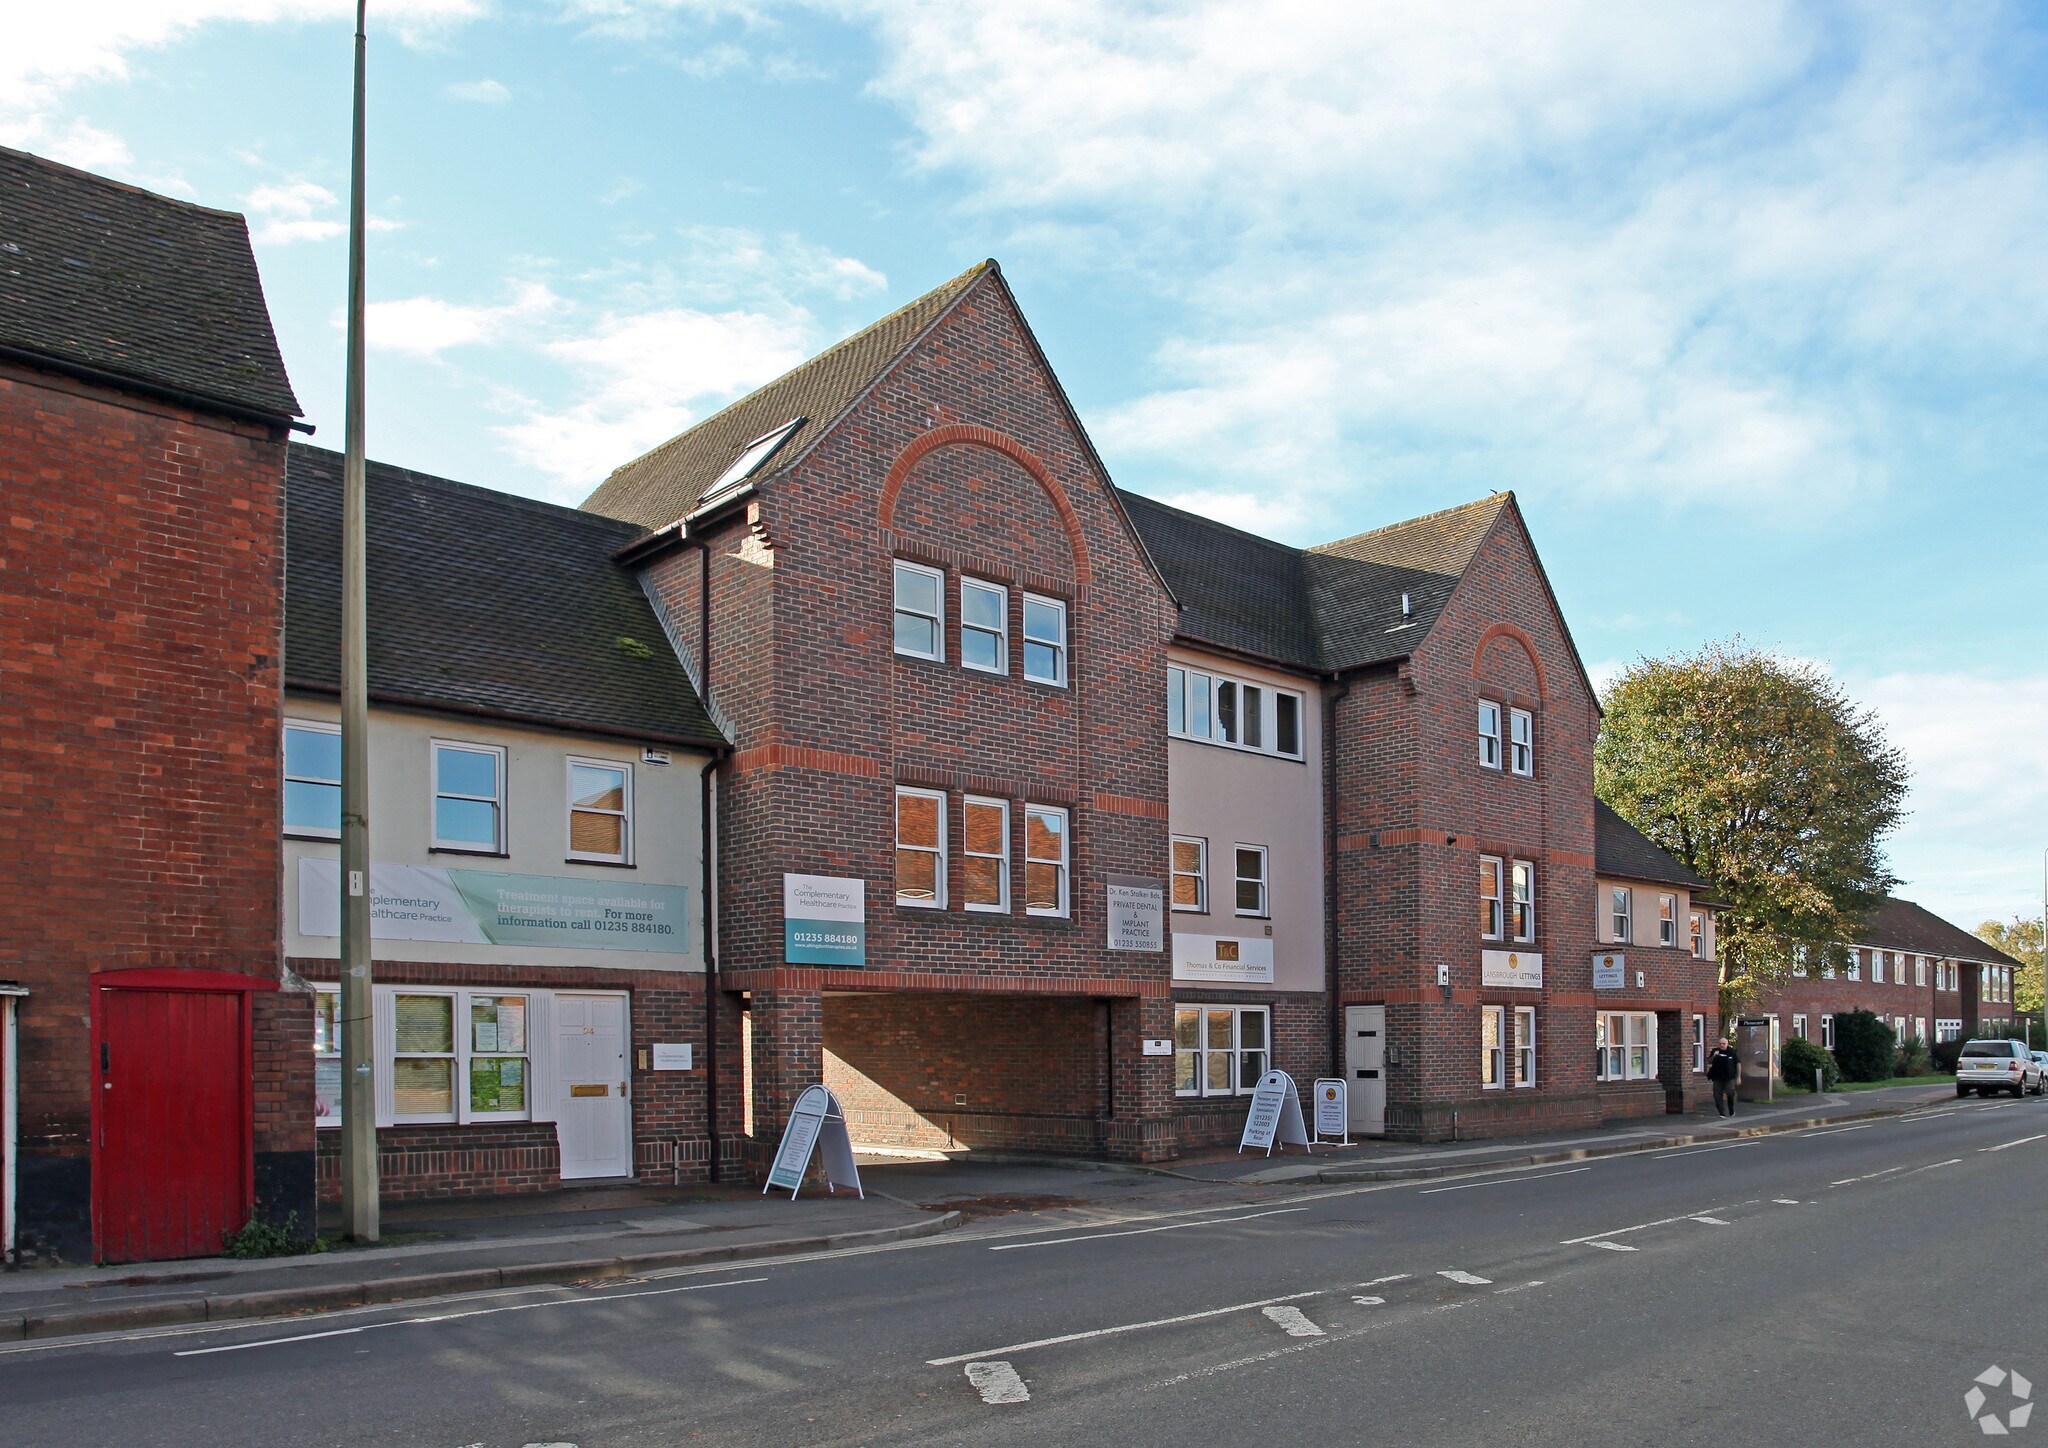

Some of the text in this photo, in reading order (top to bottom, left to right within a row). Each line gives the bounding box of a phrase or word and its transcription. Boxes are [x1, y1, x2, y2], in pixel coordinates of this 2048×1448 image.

[794, 889, 849, 901] Complementary
[1109, 887, 1118, 895] Dr.
[1119, 889, 1129, 897] Ken
[372, 895, 440, 910] plementary
[497, 889, 666, 910] Treatment space available for
[800, 899, 837, 908] Healthcare
[497, 902, 653, 921] therapists to rent. For more
[1113, 901, 1158, 911] PRIVATE DENTAL
[371, 909, 453, 923] althcare Practice
[497, 915, 675, 935] information call 01235 884180.
[794, 932, 858, 944] 01235 884180
[1122, 928, 1150, 937] PRACTICE
[1114, 939, 1157, 948] 01235 550855
[1218, 945, 1237, 958] T&C
[1484, 970, 1541, 980] LANSBROUGH LETTINGS
